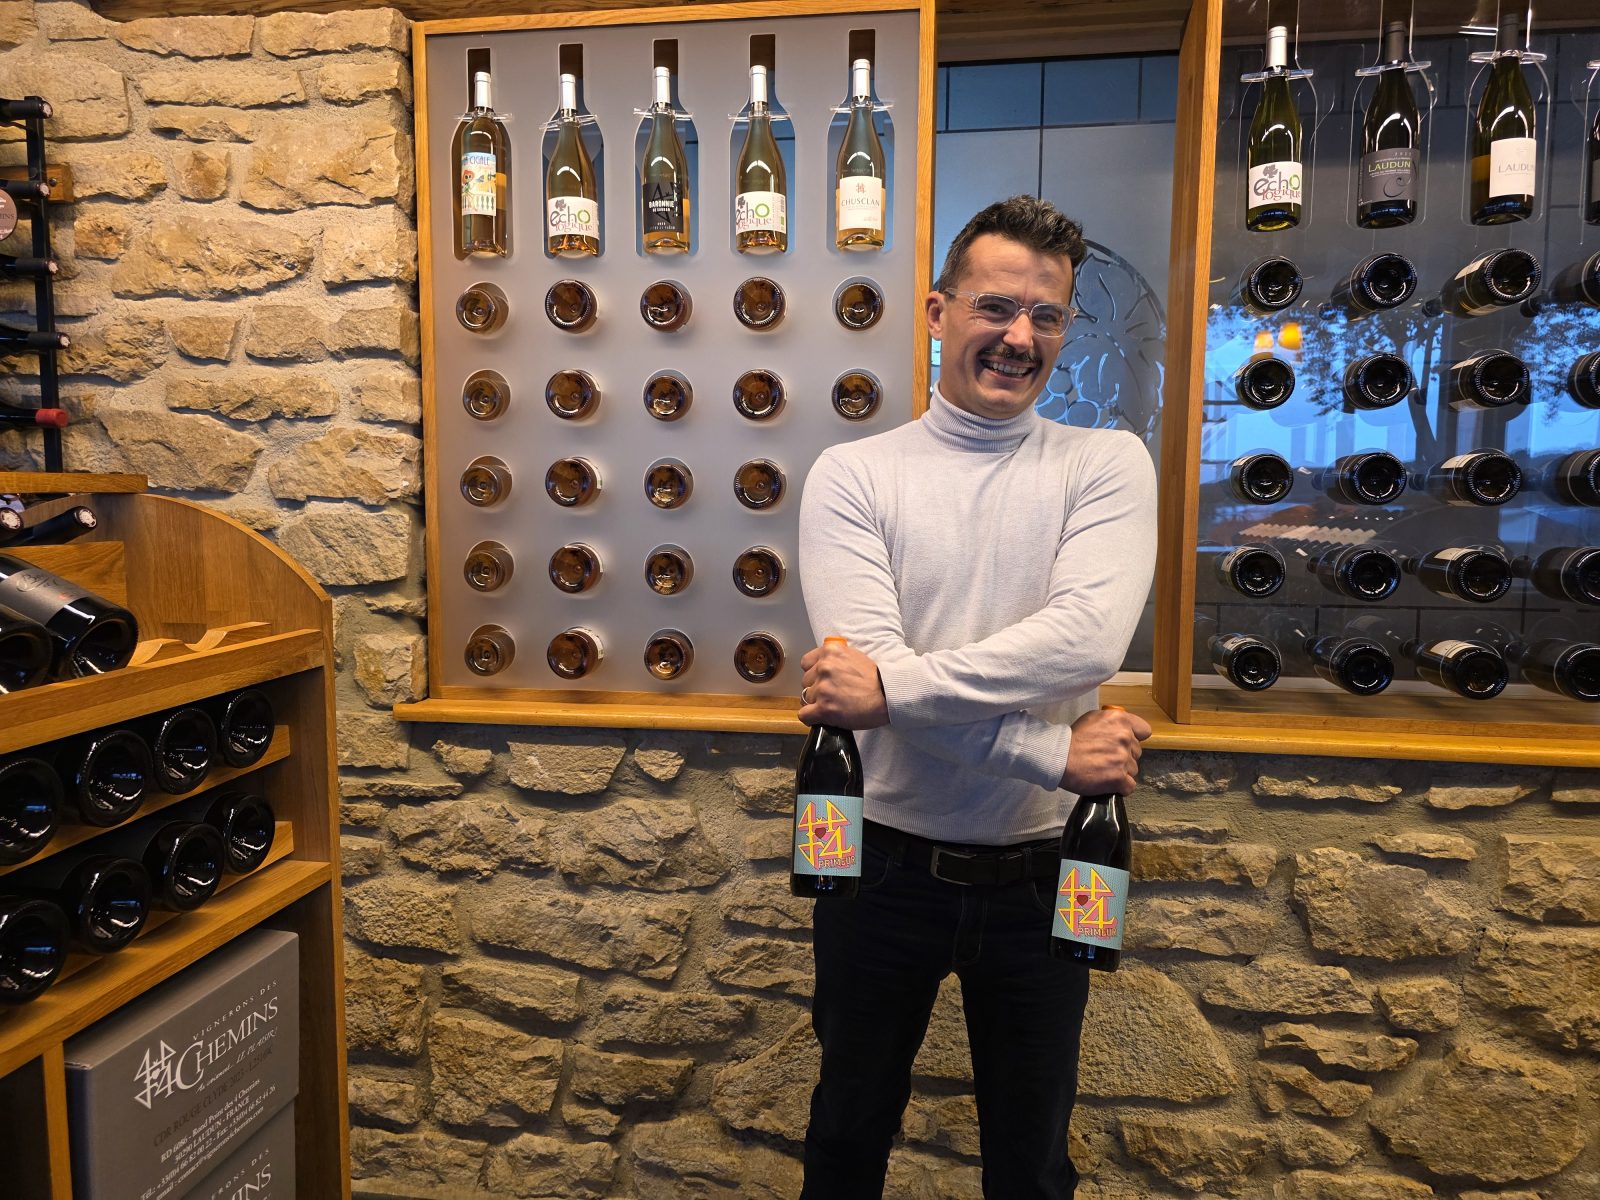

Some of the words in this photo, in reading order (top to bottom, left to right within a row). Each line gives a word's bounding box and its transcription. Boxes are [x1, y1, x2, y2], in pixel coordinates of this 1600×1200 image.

[1368, 160, 1411, 173] LAUDUN
[841, 197, 880, 207] CHUSCLAN
[819, 856, 855, 868] PRIMEUR
[1078, 928, 1117, 938] PRIMEUR
[193, 997, 254, 1041] VIGNERONS
[260, 980, 277, 996] DES
[226, 1095, 250, 1120] FRANCE
